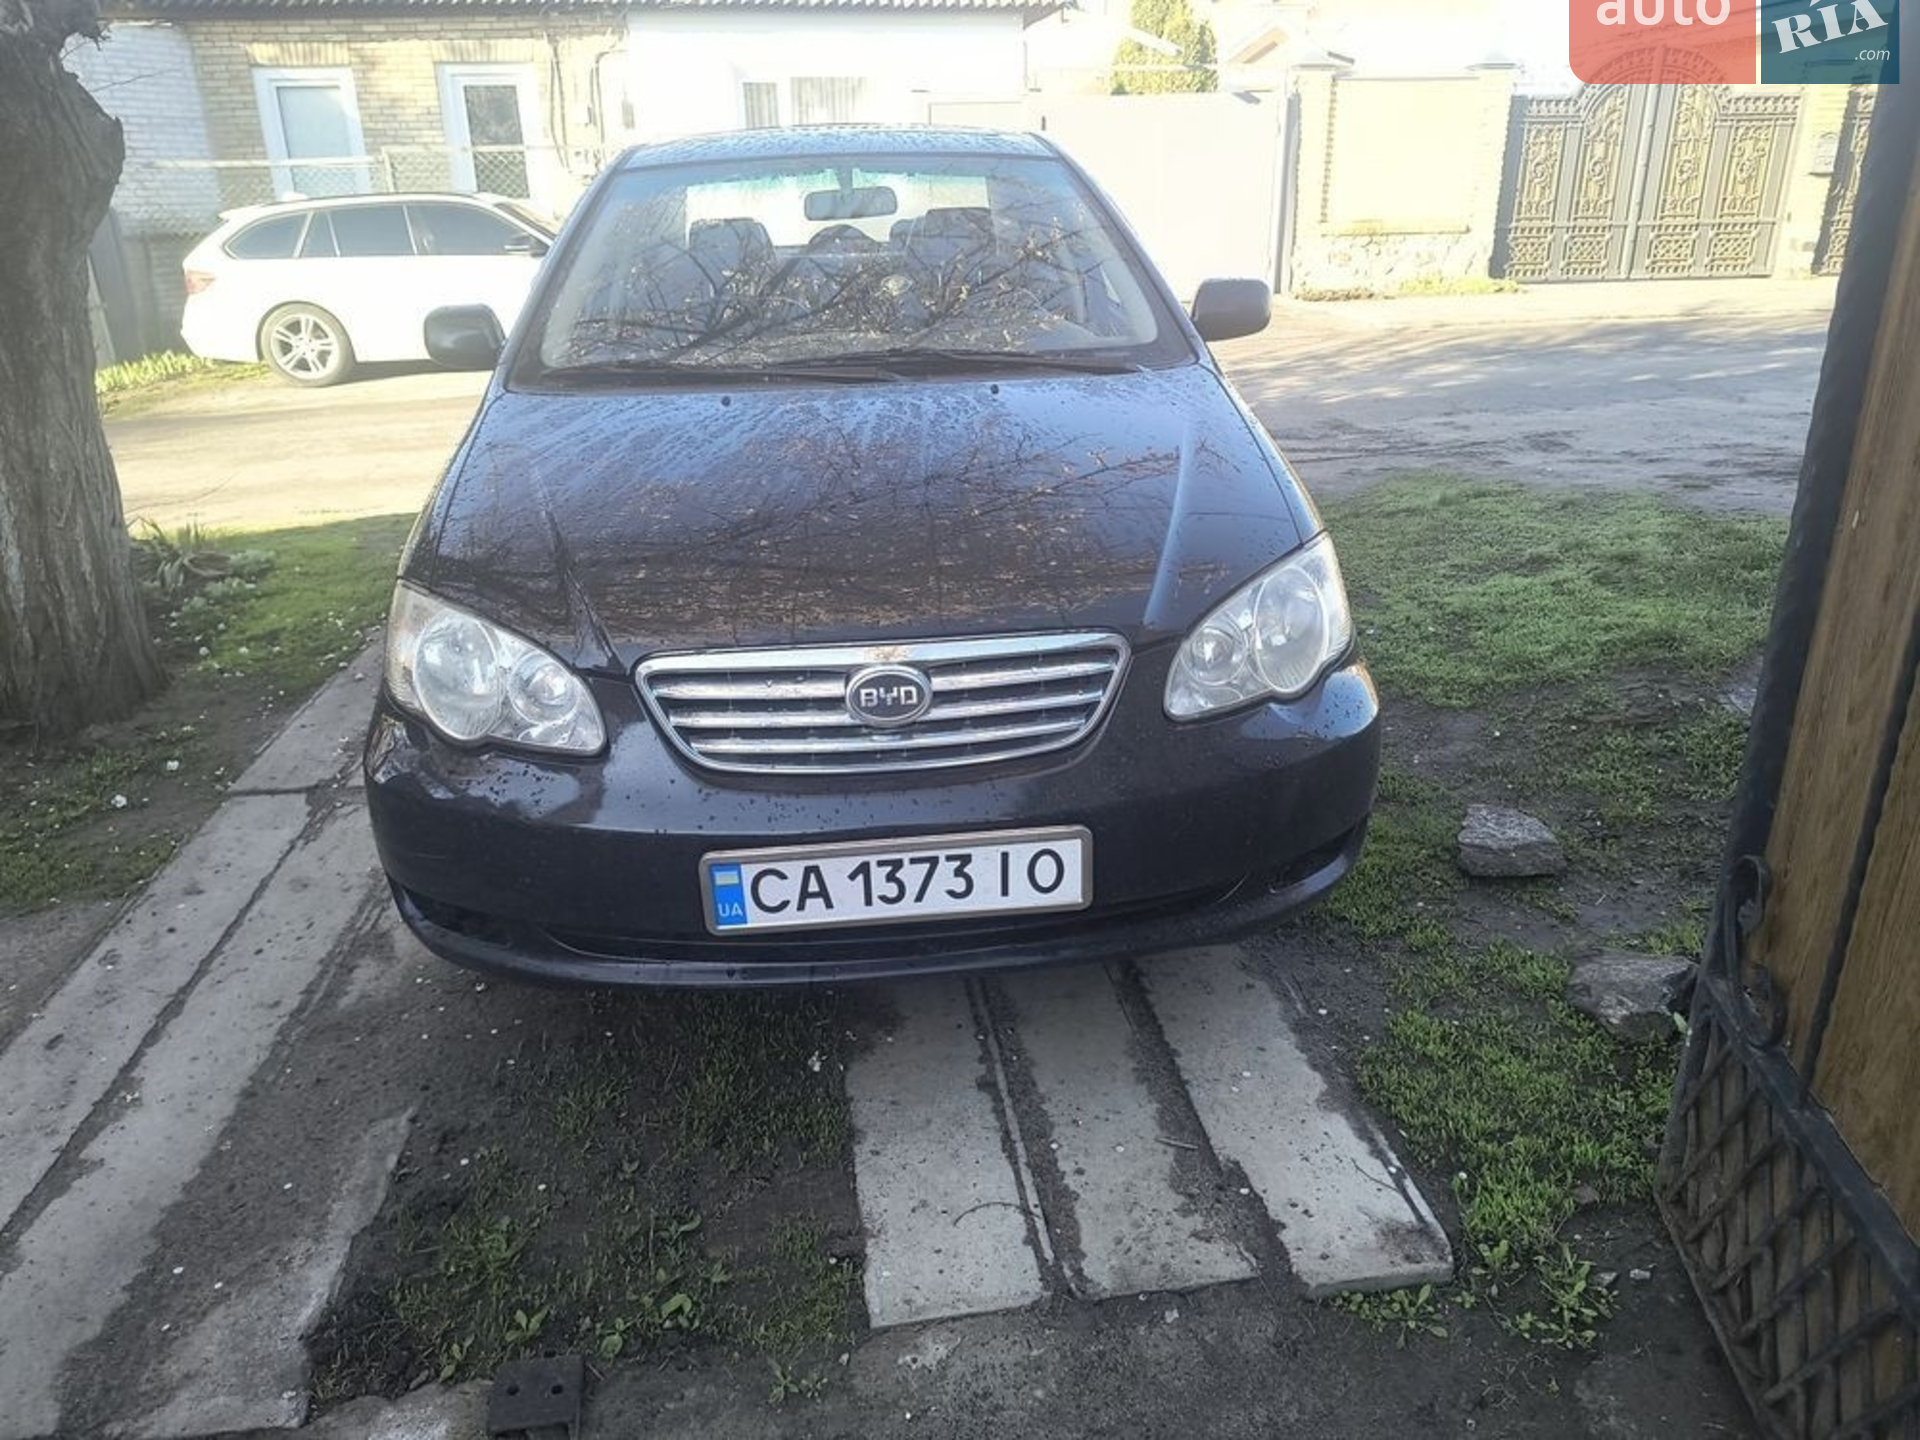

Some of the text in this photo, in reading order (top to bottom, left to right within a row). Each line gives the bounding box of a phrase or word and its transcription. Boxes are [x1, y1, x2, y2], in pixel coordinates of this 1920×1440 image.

[860, 686, 917, 707] BYD
[750, 848, 1065, 914] CA 1373 IO
[718, 904, 743, 918] UA
